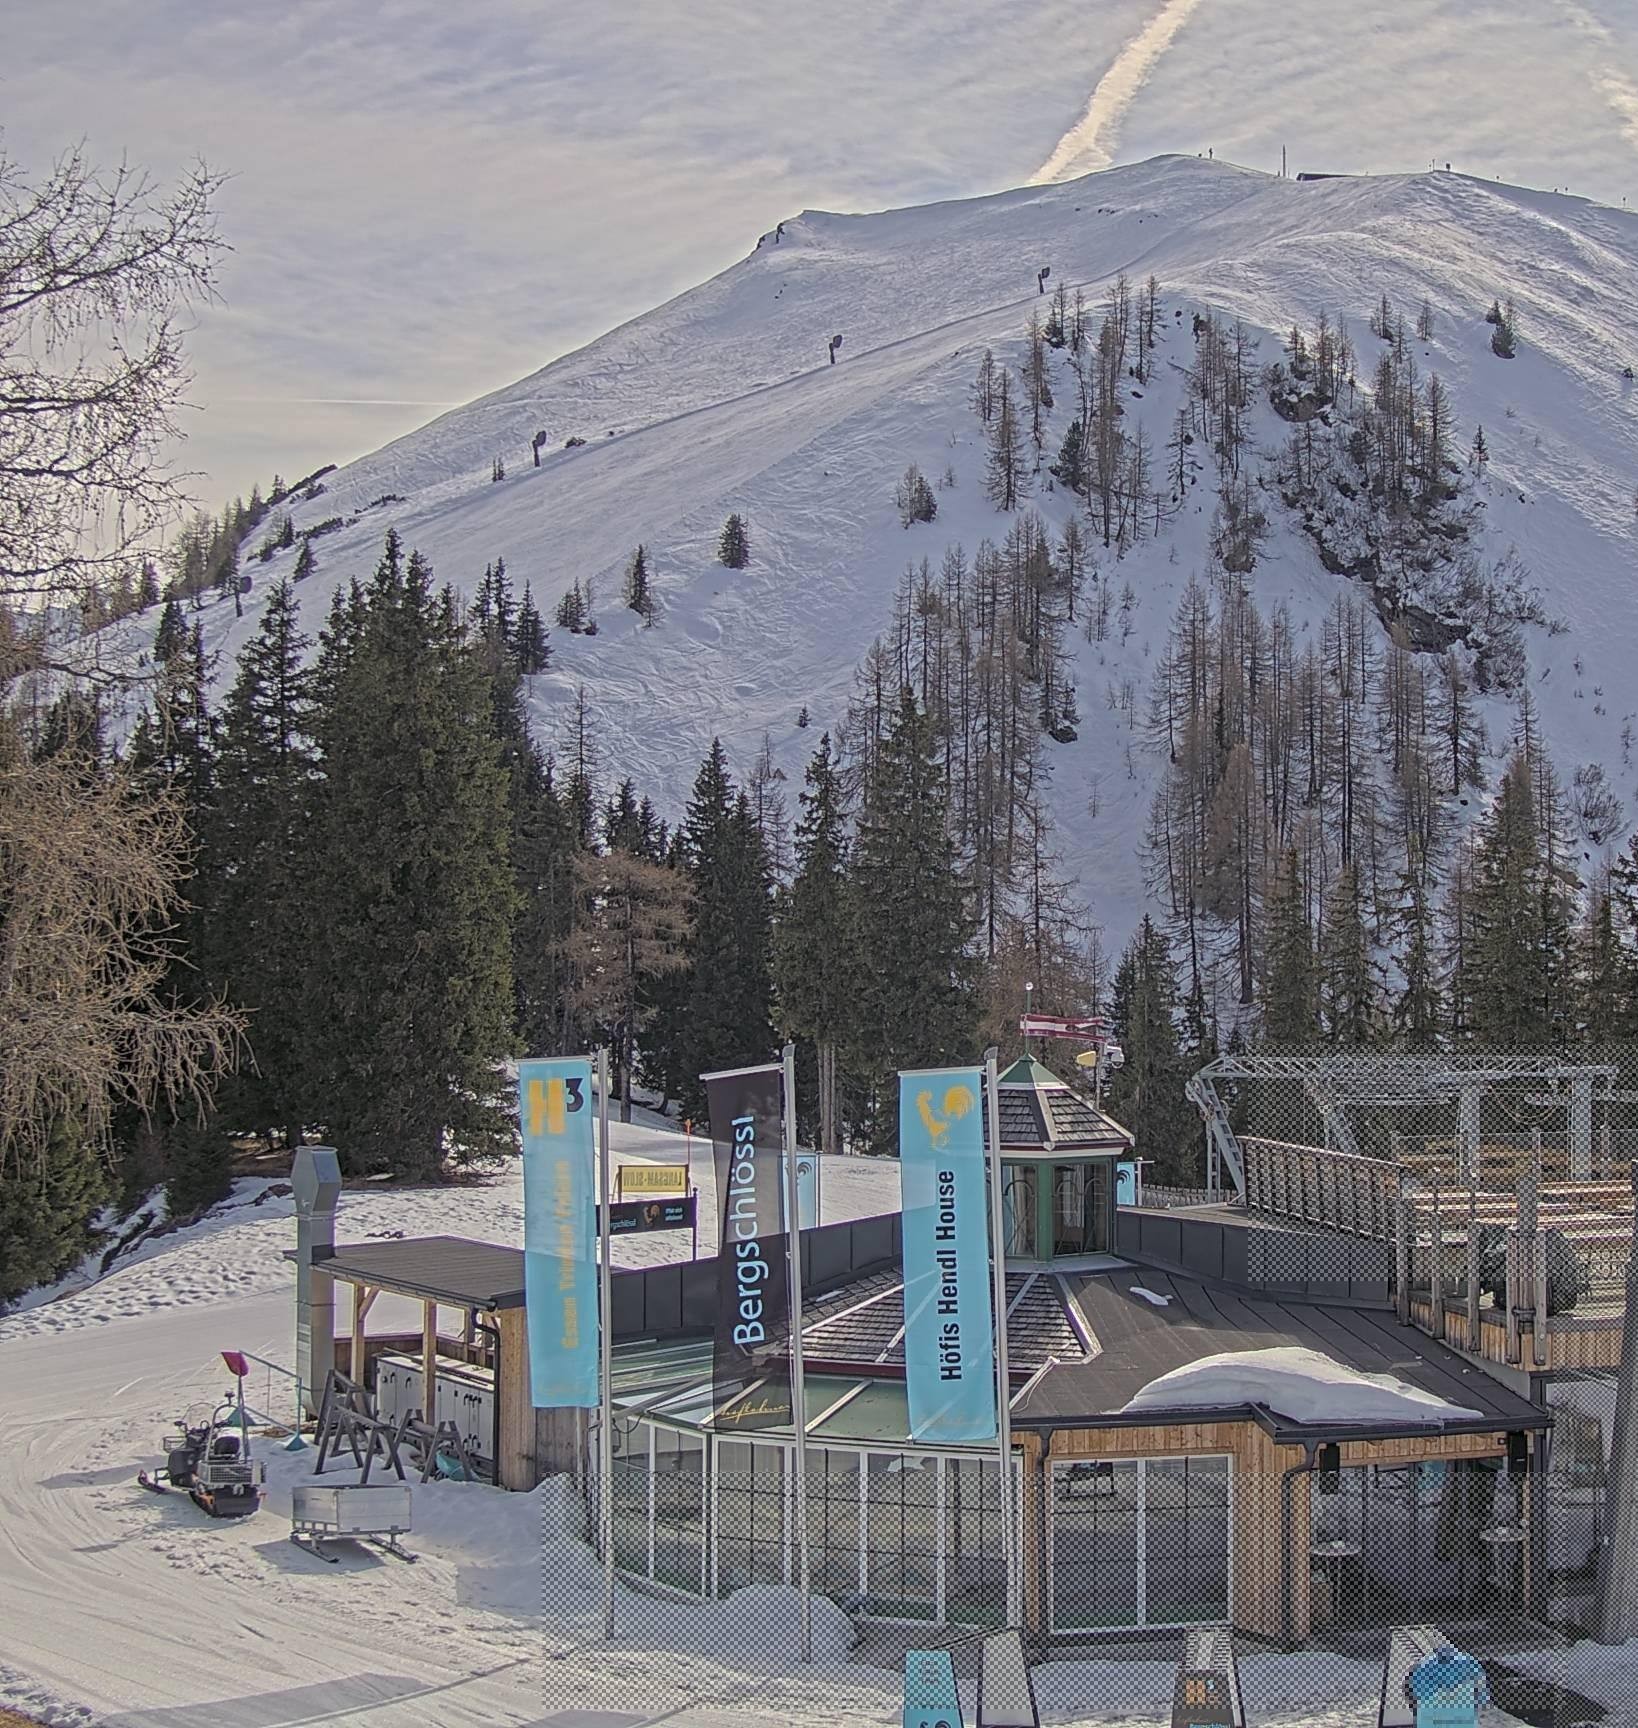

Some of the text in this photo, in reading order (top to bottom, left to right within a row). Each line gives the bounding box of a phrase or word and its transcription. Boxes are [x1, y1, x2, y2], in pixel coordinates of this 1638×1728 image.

[730, 1114, 769, 1345] Bergschlössl
[935, 1170, 963, 1381] Höfis Hendl House
